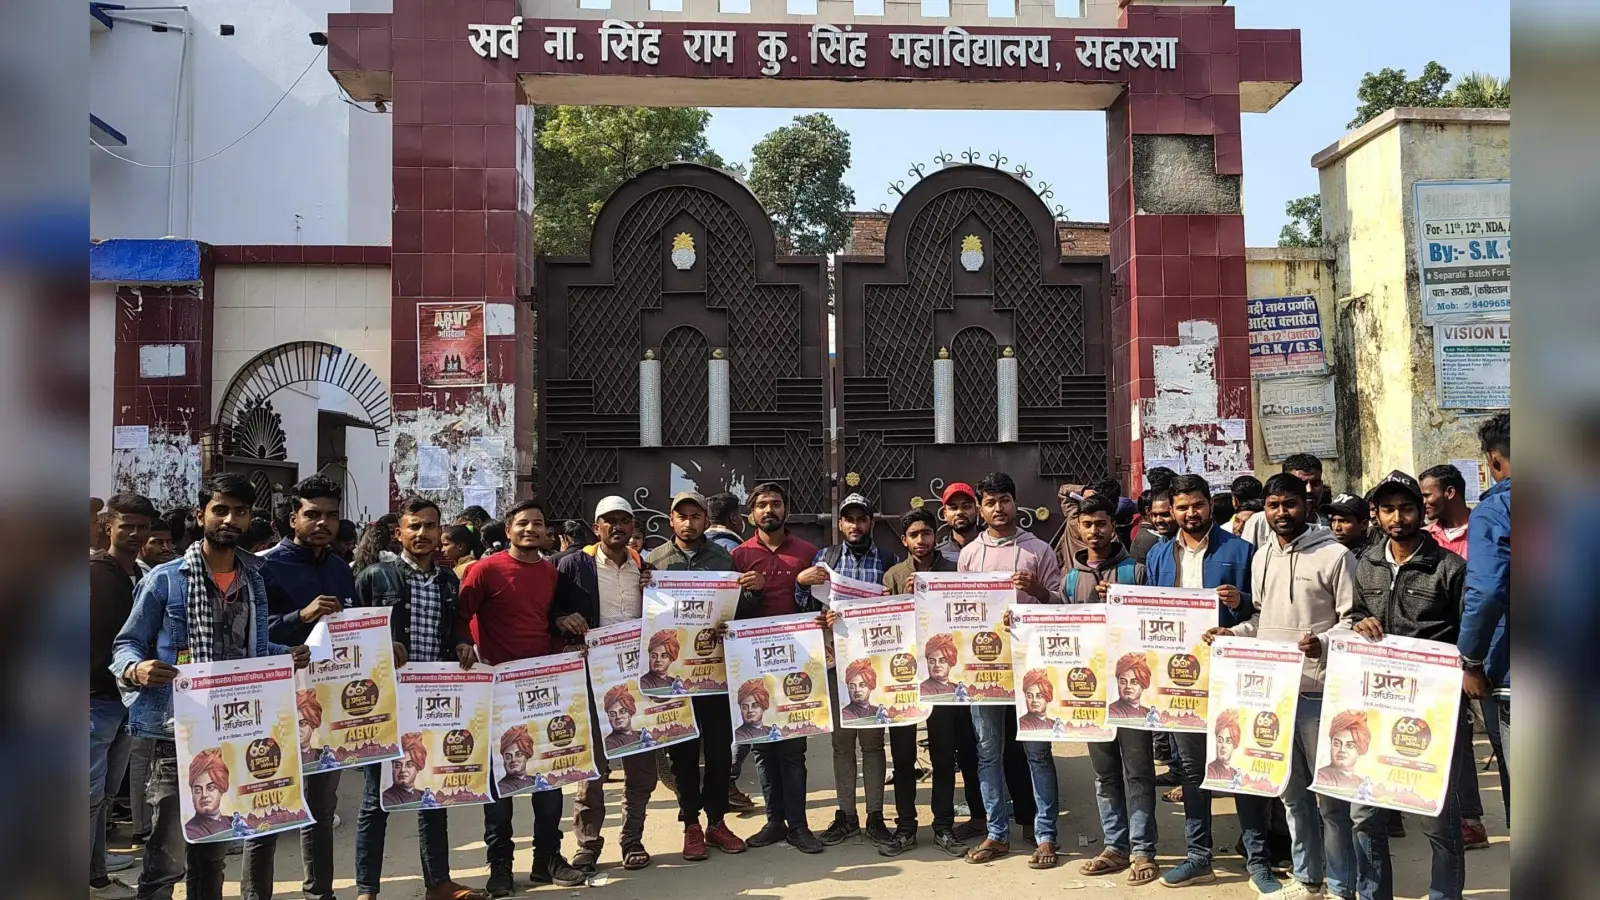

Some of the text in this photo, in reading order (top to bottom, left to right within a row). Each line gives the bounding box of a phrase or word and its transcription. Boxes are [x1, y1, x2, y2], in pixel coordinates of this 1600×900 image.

[468, 16, 1179, 75] सर्व ना. सिंह राम कु. सिंह महाविद्यालय, सहरसा
[1468, 240, 1504, 260] S.K.
[1433, 268, 1505, 280] Separate Batch For
[1265, 302, 1286, 313] नाथ
[1287, 297, 1315, 312] प्रगति
[1437, 302, 1459, 310] Mob:
[434, 311, 471, 328] ABVP
[1277, 312, 1318, 327] क्लासेज
[1444, 326, 1494, 340] VISION
[1261, 343, 1287, 355] G.K.
[1295, 341, 1321, 352] G.S.
[1283, 405, 1324, 415] Classes
[681, 597, 704, 612] प्रांत
[953, 599, 977, 615] प्रांत
[869, 623, 892, 640] प्रांत
[1149, 617, 1175, 633] प्रांत
[1047, 633, 1070, 649] प्रांत
[762, 643, 786, 660] प्रांत
[1372, 670, 1405, 690] प्रांत
[425, 693, 452, 711] प्रांत
[525, 685, 549, 703] प्रांत
[222, 698, 251, 720] प्रांत
[346, 725, 380, 743] ABVP
[443, 774, 471, 788] ABVP
[254, 790, 285, 808] ABVP
